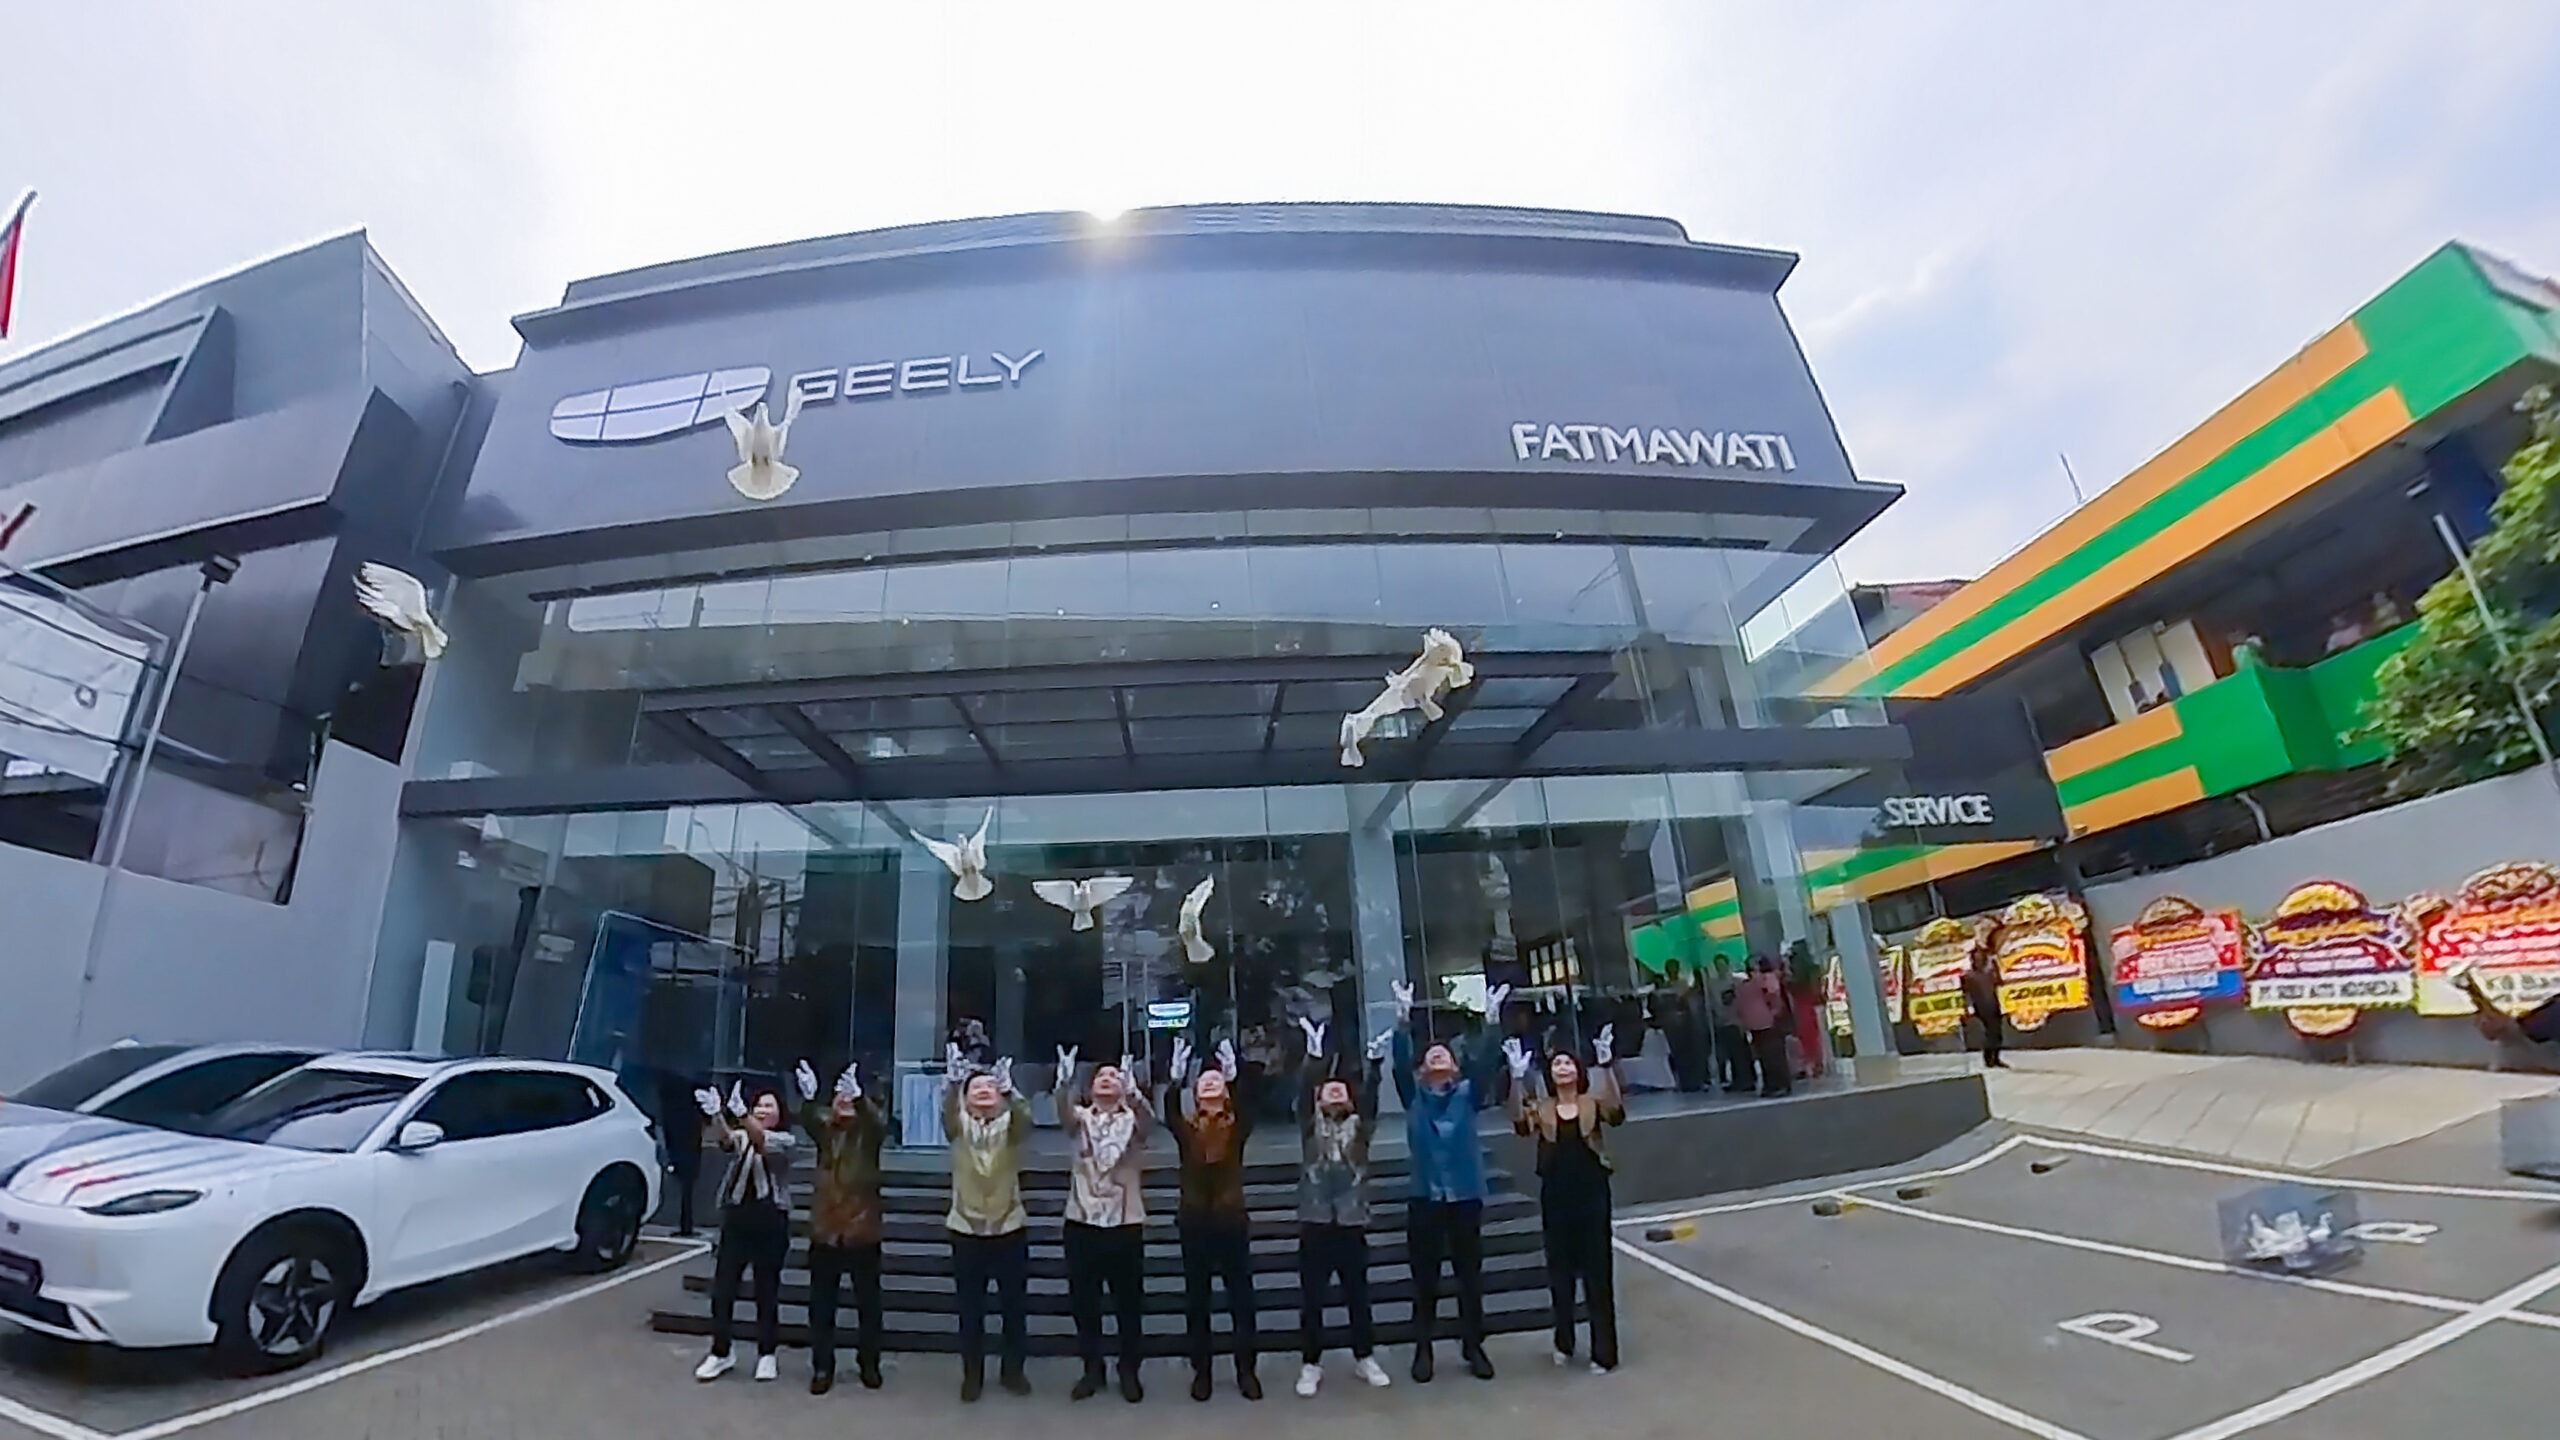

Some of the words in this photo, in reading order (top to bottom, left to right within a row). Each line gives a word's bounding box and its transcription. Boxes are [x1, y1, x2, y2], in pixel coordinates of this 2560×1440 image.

[792, 349, 1044, 402] GEELY
[1511, 423, 1797, 471] FATMAWATI
[1883, 794, 1993, 826] SERVICE
